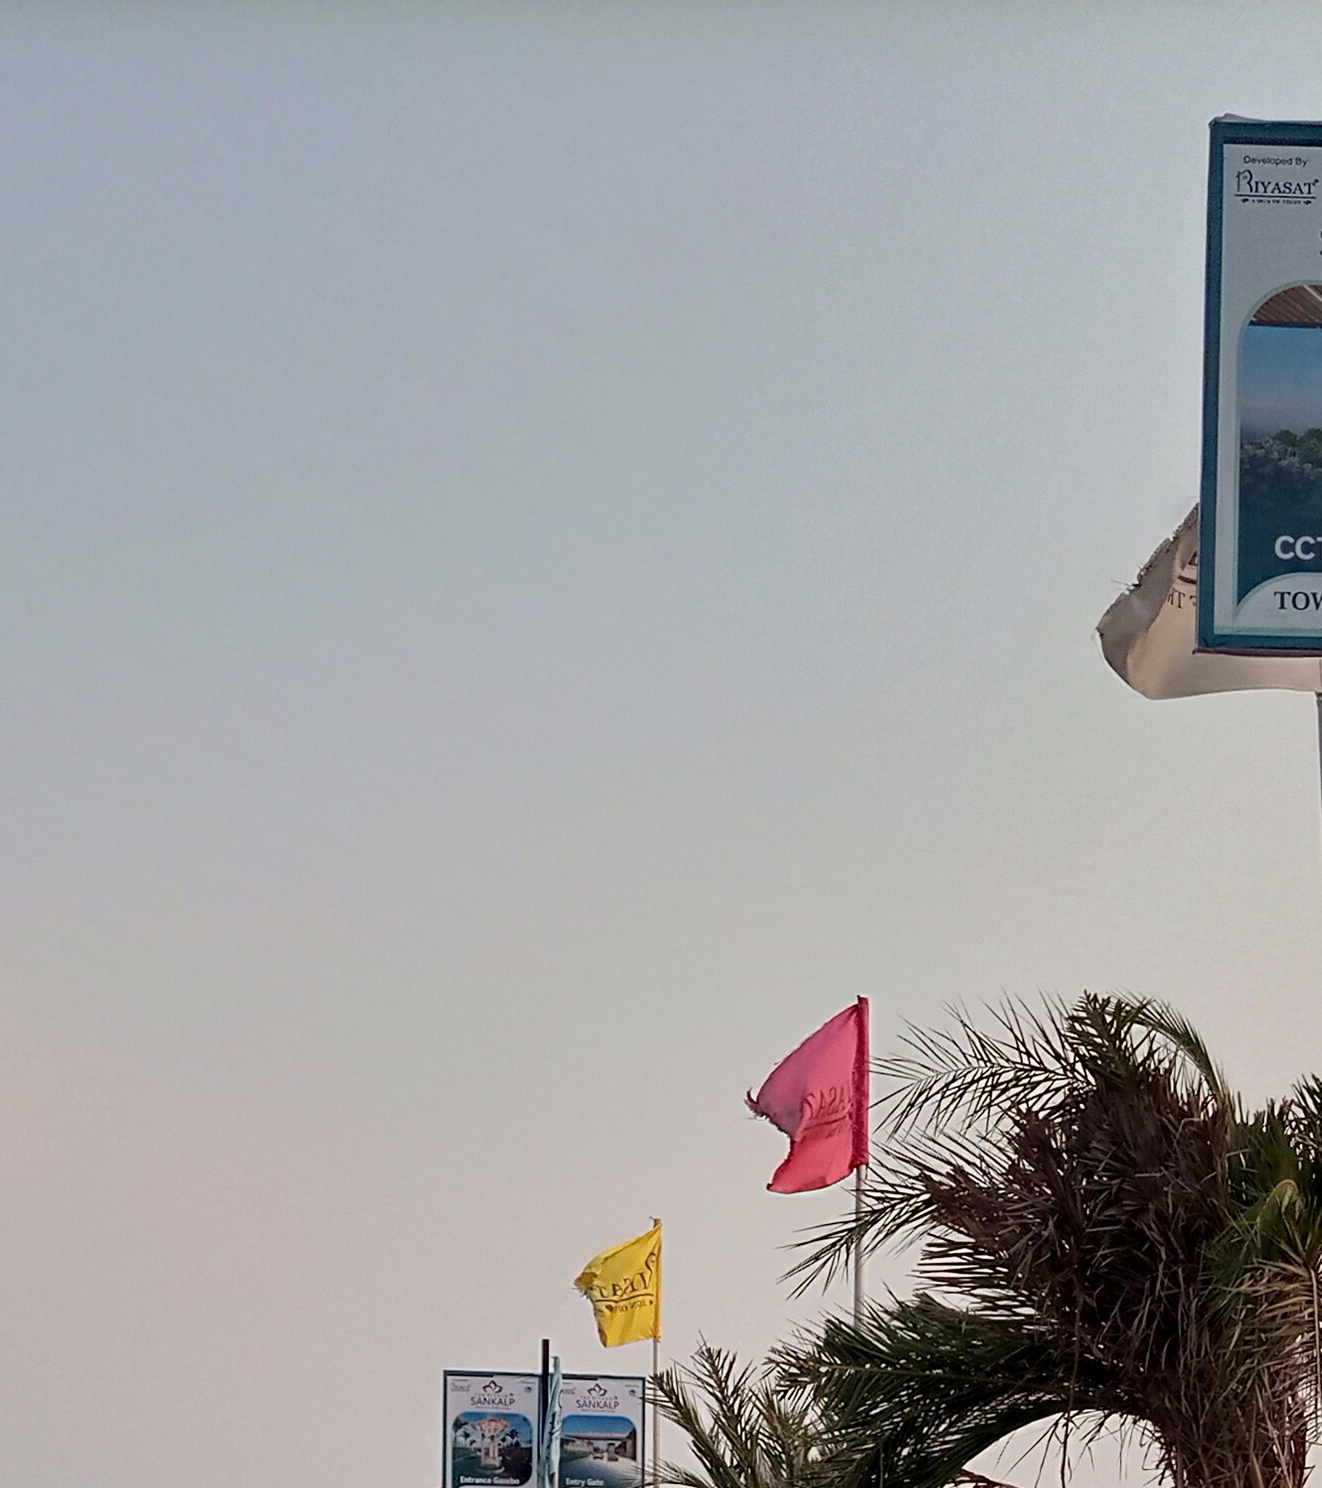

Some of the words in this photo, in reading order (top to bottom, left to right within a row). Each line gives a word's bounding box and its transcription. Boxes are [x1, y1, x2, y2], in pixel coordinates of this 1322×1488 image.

[1243, 155, 1293, 166] Developed
[1235, 169, 1315, 195] RIYASAT
[470, 1396, 515, 1407] SANKALP
[575, 1399, 620, 1409] SANKALP
